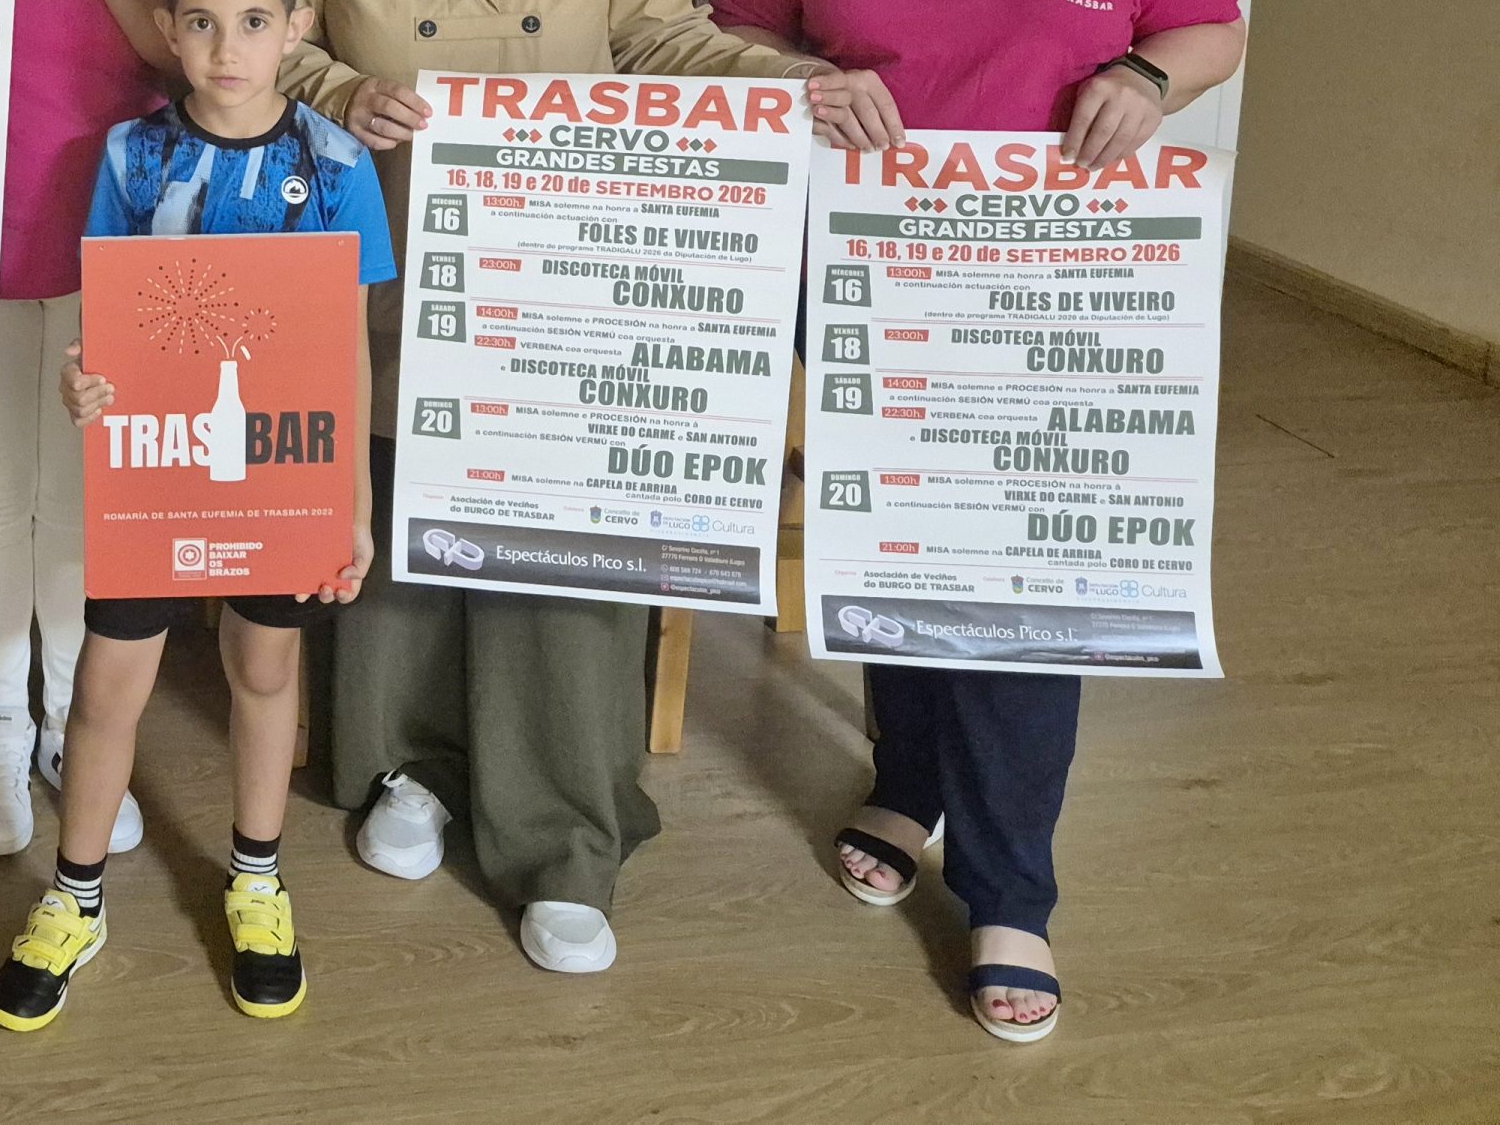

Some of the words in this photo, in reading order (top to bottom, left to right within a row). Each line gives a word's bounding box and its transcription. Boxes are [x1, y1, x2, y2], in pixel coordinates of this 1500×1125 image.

[436, 76, 792, 134] TRASBAR
[549, 124, 670, 153] CERVO
[496, 148, 616, 173] GRANDES
[623, 157, 720, 177] FESTAS
[831, 143, 1208, 191] TRASBAR
[641, 202, 673, 215] SANTA
[676, 205, 719, 218] EUFEMIA
[955, 193, 1080, 217] CERVO
[431, 207, 460, 231] 16
[899, 218, 1027, 238] GRANDES
[1034, 219, 1132, 240] FESTAS
[428, 264, 457, 288] 18
[542, 259, 630, 280] DISCOTECA
[633, 263, 684, 284] MÓVIL
[613, 280, 744, 315] CONXURO
[989, 290, 1051, 312] FOLES
[1059, 291, 1085, 311] DE
[1091, 291, 1175, 312] VIVEIRO
[427, 314, 456, 337] 19
[420, 410, 452, 433] 20
[1048, 407, 1195, 435] ALABAMA
[102, 411, 336, 468] TRASBAR
[103, 511, 148, 520] ROMARÍA
[168, 511, 198, 519] SANTA
[202, 510, 244, 518] EUFEMIA
[264, 509, 308, 517] TRASBAR
[311, 508, 333, 516] 2022
[1027, 509, 1097, 543] DÚO
[1108, 514, 1195, 546] EPOK
[209, 542, 263, 550] PROHIBIDO
[209, 551, 246, 559] BAIXAR
[209, 560, 222, 568] OS
[496, 545, 589, 568] Espectáculos
[593, 551, 622, 570] Pico
[625, 557, 646, 573] s.l.
[209, 568, 250, 576] BRAZOS
[916, 620, 1014, 640] Espectáculos
[1020, 626, 1051, 641] Pico
[1056, 627, 1077, 643] s.l.
